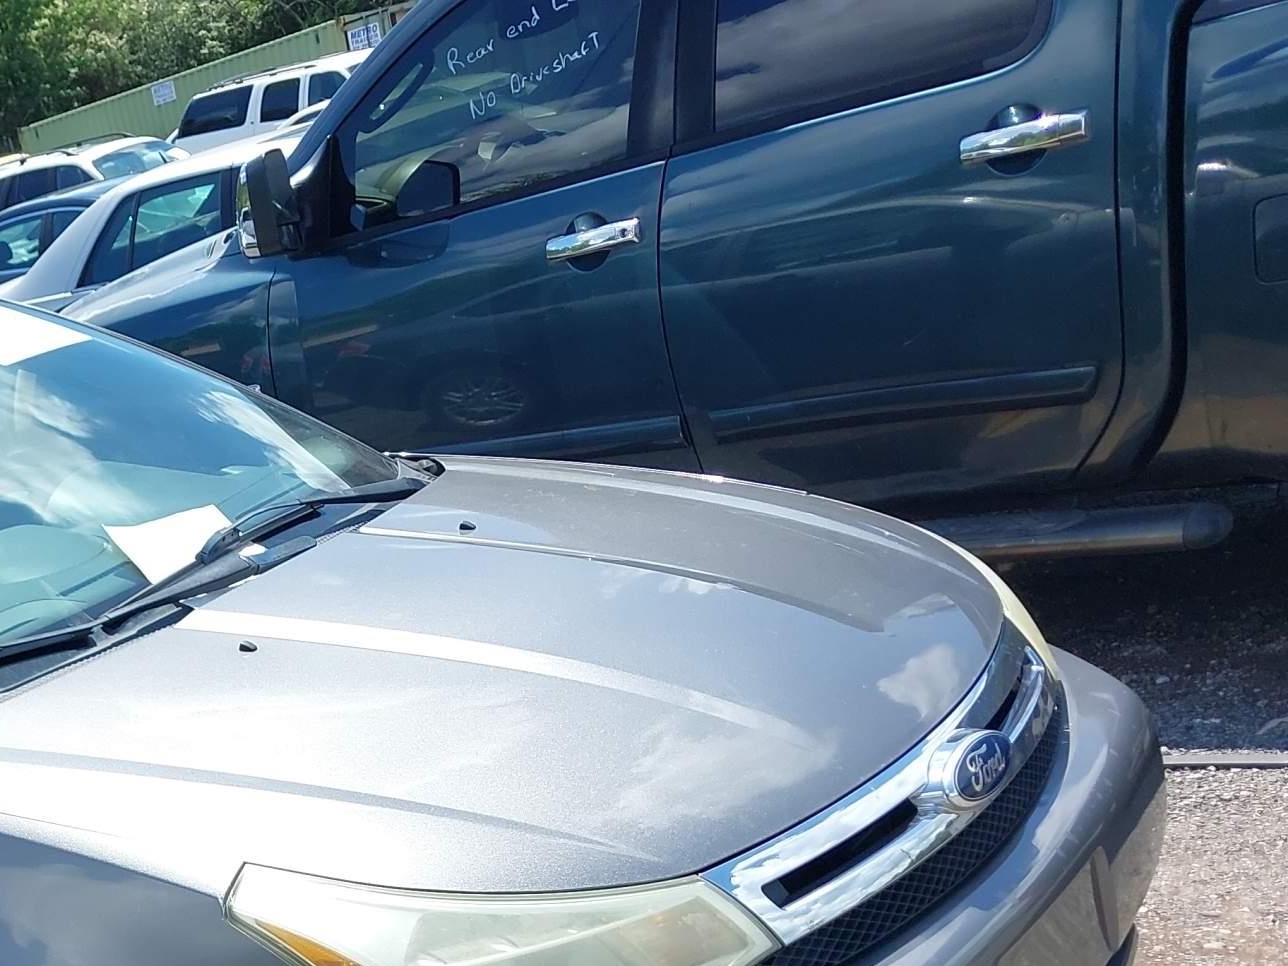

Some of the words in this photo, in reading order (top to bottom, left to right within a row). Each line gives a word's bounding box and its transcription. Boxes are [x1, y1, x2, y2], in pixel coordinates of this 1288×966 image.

[447, 39, 495, 75] Rear
[506, 6, 540, 38] end
[966, 742, 1006, 792] Ford
